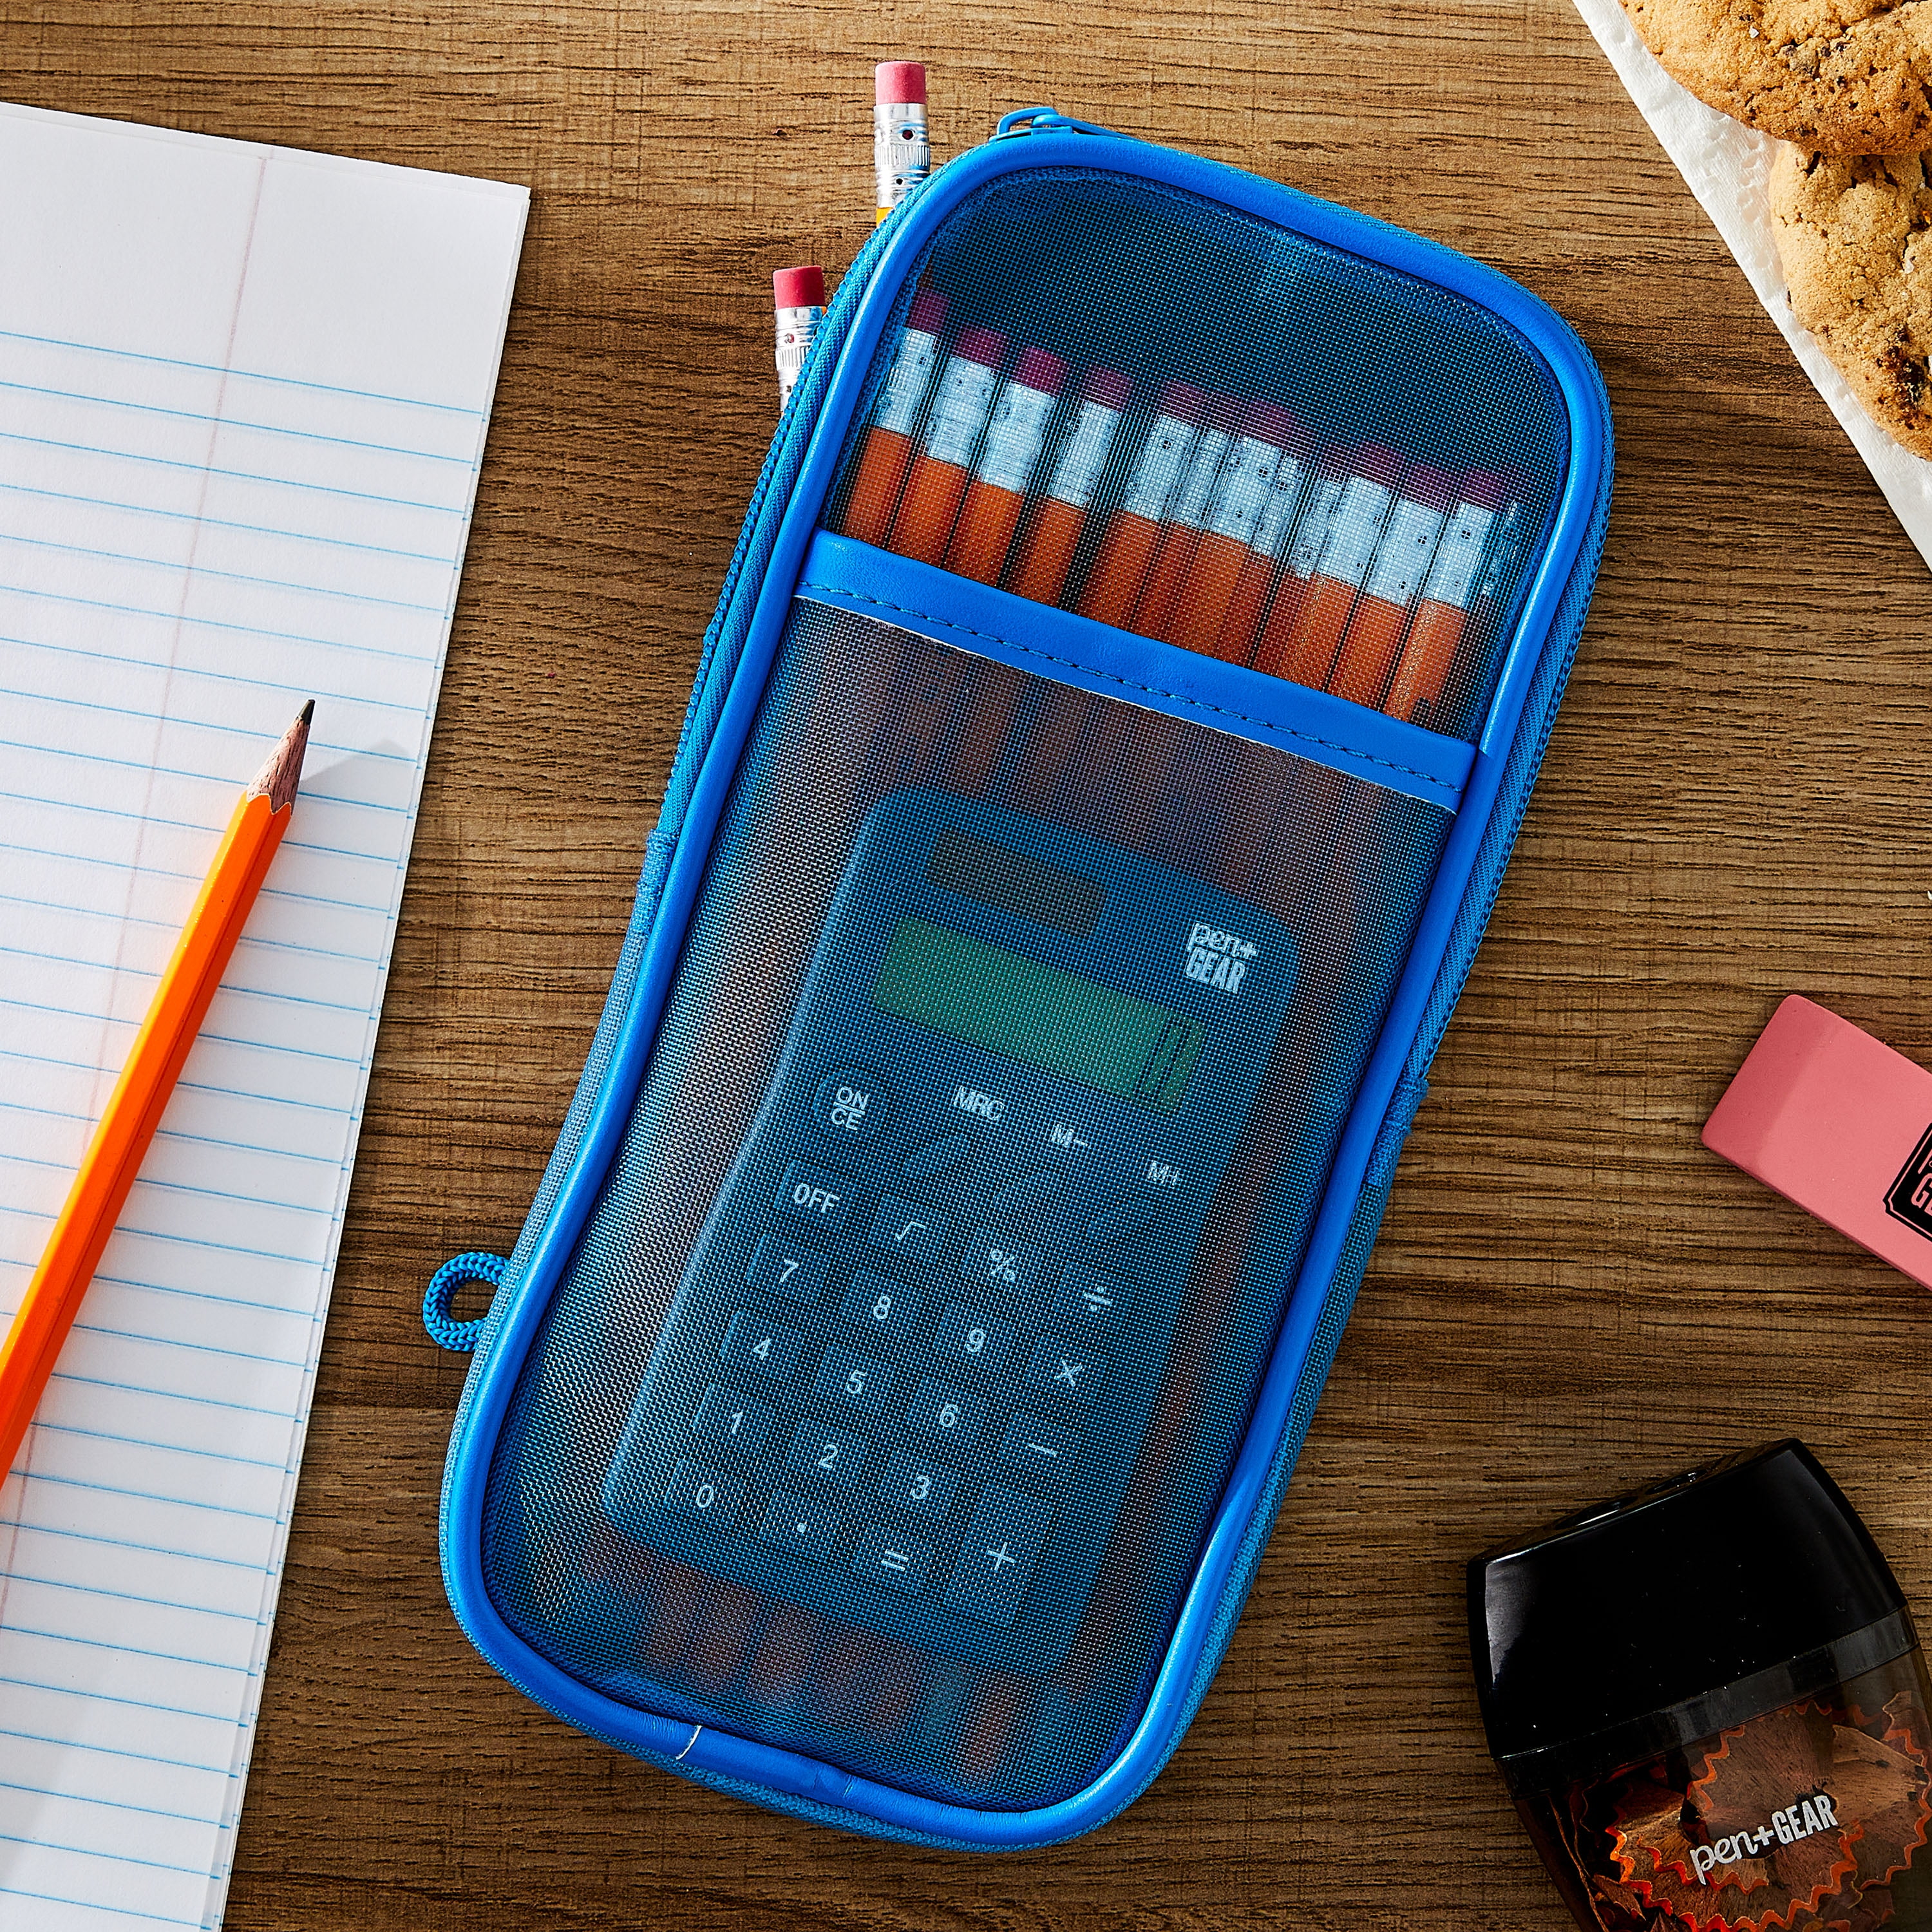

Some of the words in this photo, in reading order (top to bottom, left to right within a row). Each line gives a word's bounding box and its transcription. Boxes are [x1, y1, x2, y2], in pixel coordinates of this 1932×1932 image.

[1187, 923, 1258, 958] pen+
[1186, 947, 1246, 994] GEAR
[837, 1085, 869, 1110] ON
[953, 1085, 1005, 1121] MRC
[831, 1107, 862, 1132] CE
[793, 1183, 840, 1220] OFF
[779, 1260, 799, 1283] 7
[990, 1248, 1016, 1283] %
[873, 1295, 893, 1320] 8
[752, 1337, 770, 1361] 4
[966, 1328, 986, 1353] 9
[846, 1370, 867, 1395] 5
[731, 1412, 744, 1435] 1
[939, 1403, 960, 1428] 6
[819, 1444, 839, 1469] 2
[911, 1475, 932, 1500] 3
[987, 1541, 1016, 1571] +
[1689, 1795, 1839, 1886] pen+GEAR
